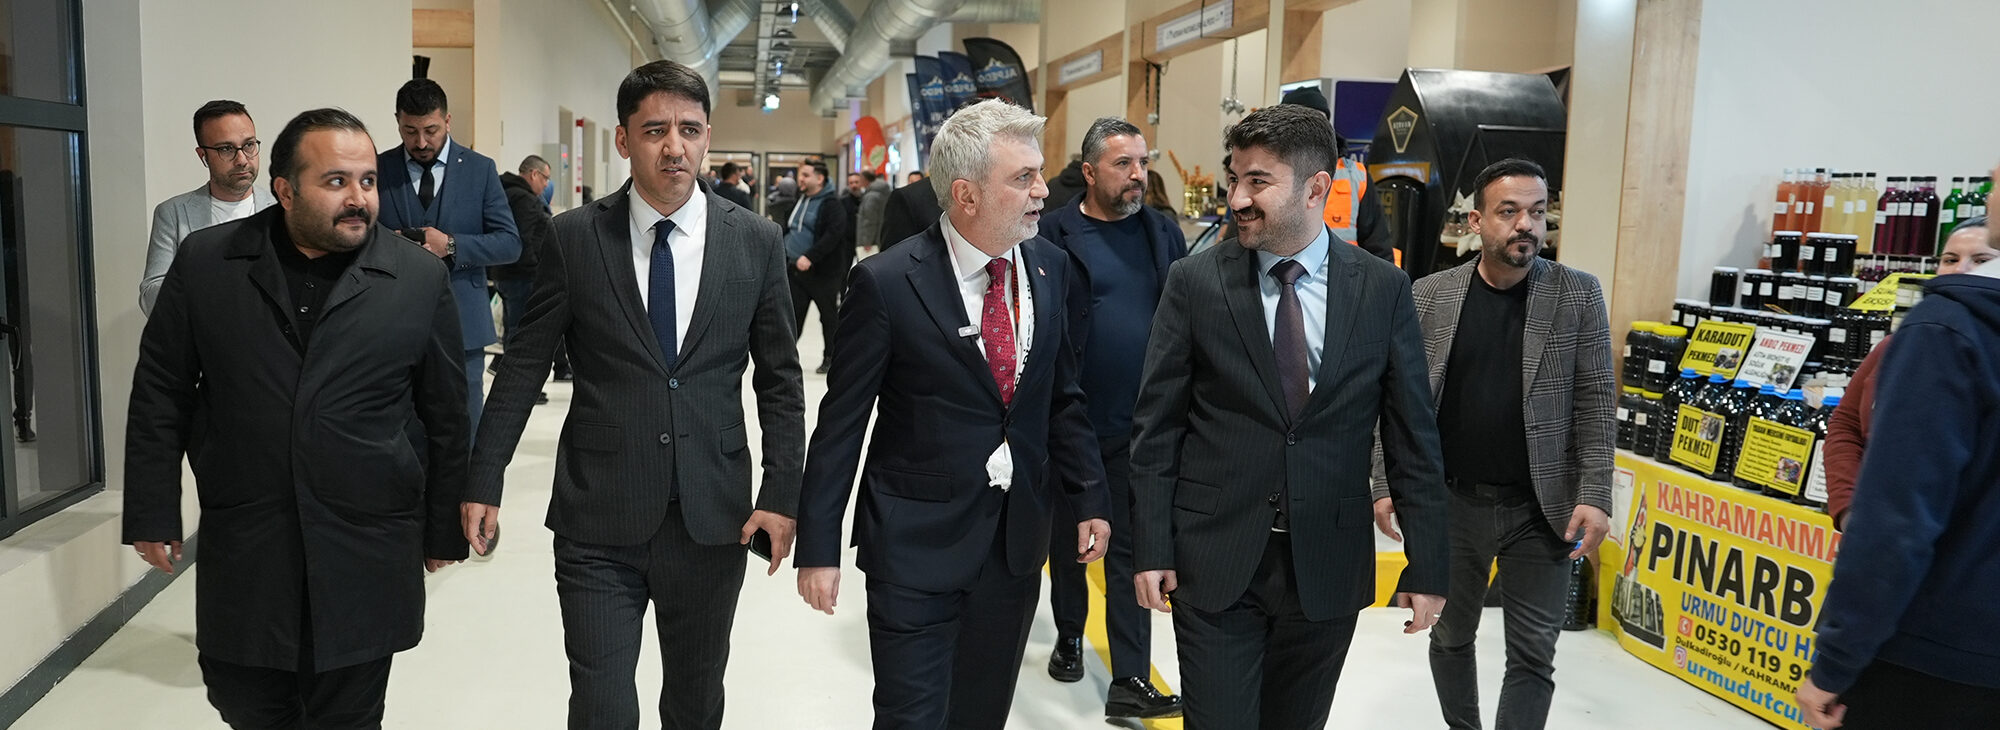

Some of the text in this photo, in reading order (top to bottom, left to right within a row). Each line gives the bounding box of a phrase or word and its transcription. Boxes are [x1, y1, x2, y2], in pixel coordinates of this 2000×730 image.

[1696, 329, 1747, 347] KARADUT
[1682, 415, 1700, 434] DUT
[1681, 591, 1727, 627] URMU
[1731, 611, 1788, 652] DUTCU
[1675, 636, 1732, 667] Dulkadiroğlu
[1695, 624, 1741, 656] 0530
[1748, 646, 1781, 673] 119
